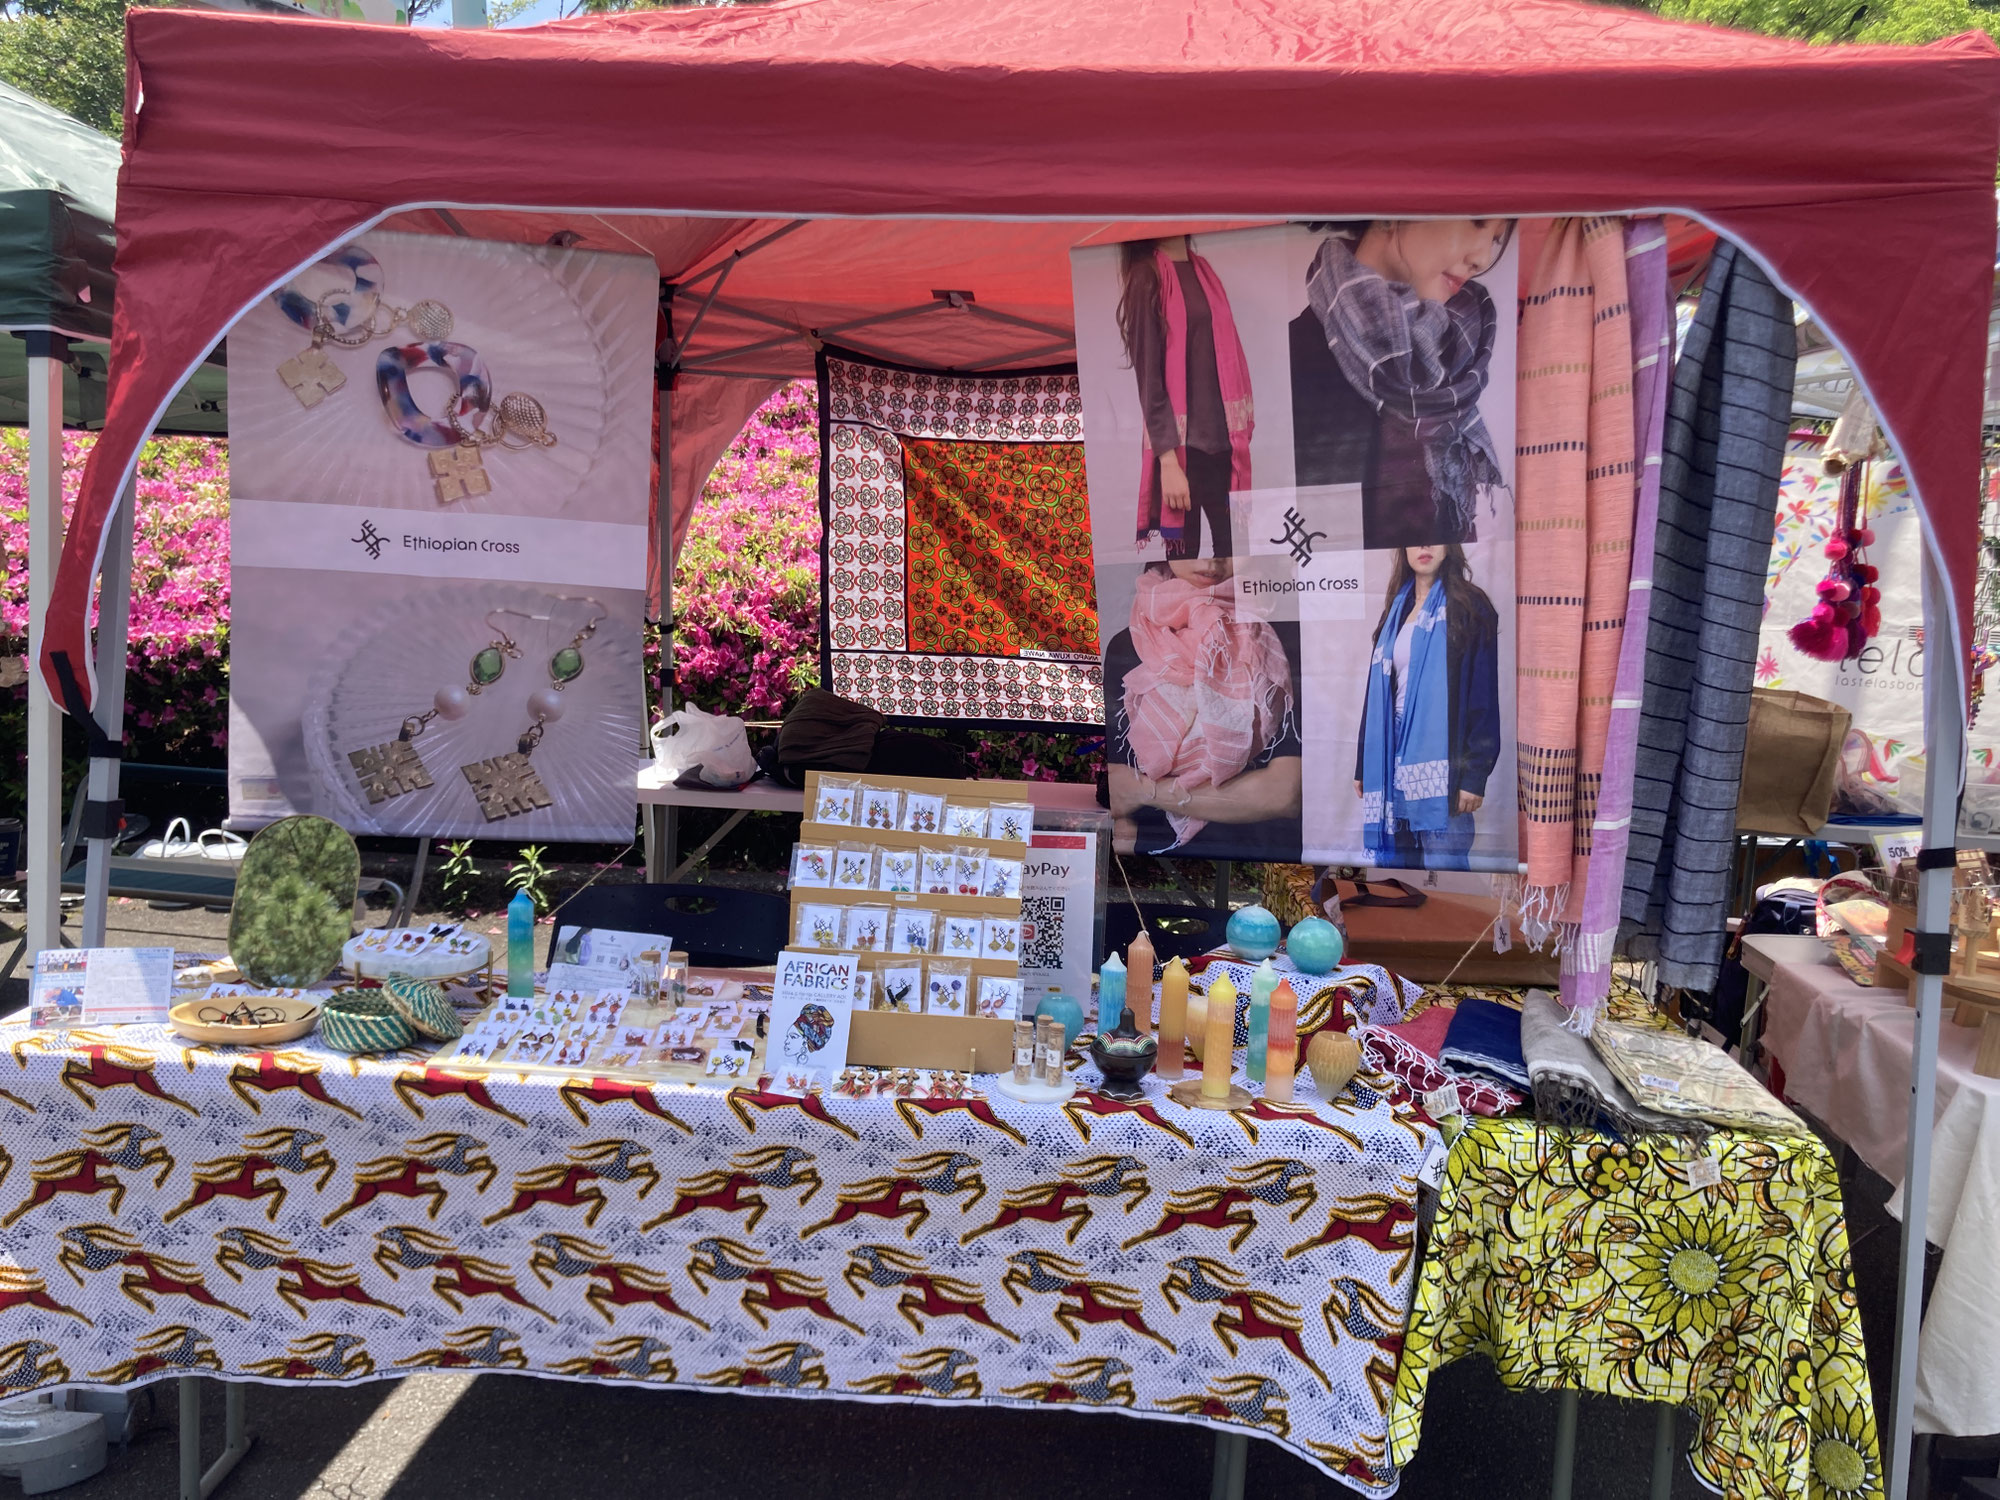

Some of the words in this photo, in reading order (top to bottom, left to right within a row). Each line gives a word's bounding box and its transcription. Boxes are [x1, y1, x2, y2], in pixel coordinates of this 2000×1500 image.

[403, 534, 477, 552] Ethiopian
[481, 539, 520, 554] Cross
[1242, 579, 1315, 596] Ethiopian
[1318, 577, 1359, 591] Cross
[1887, 846, 1910, 858] 50%
[1023, 862, 1070, 879] ayPay
[784, 960, 849, 977] AFRICAN
[783, 973, 849, 991] FABRICS
[1347, 1476, 1379, 1496] VERITABLE
